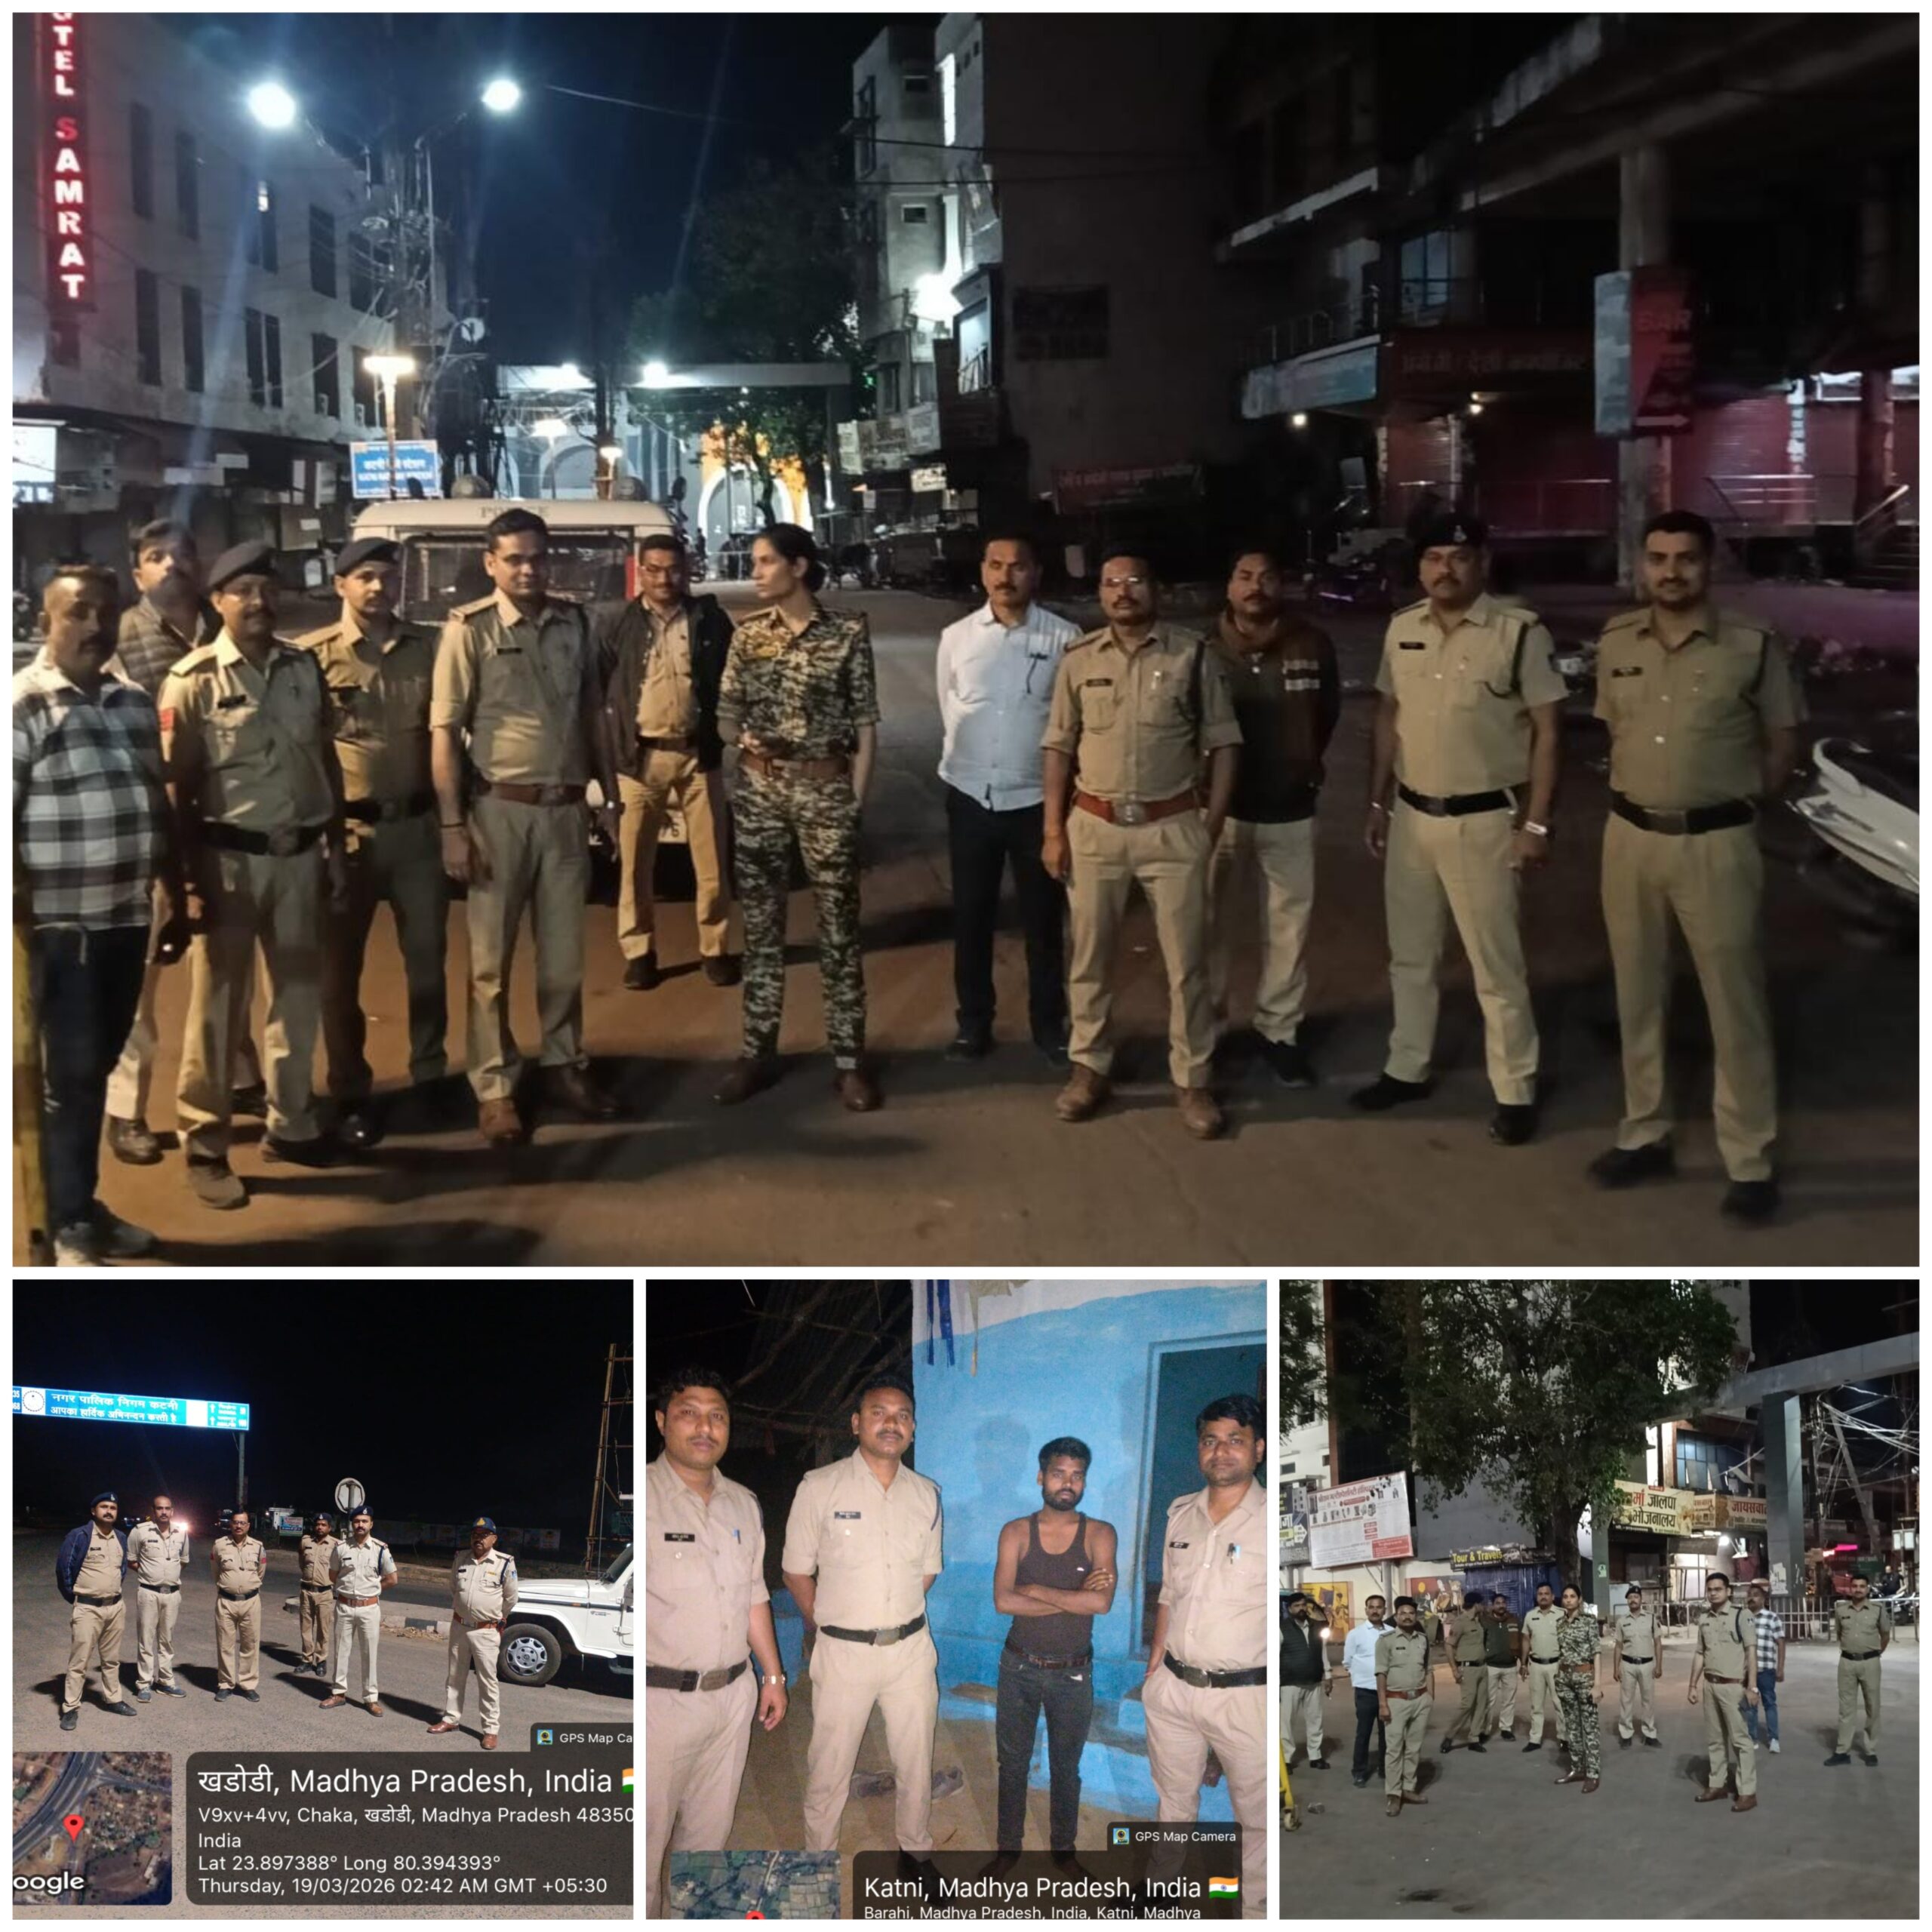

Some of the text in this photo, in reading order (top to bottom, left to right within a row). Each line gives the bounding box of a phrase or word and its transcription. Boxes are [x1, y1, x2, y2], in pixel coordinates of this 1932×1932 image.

[54, 117, 85, 299] SAMRAT
[51, 1392, 179, 1411] नगर पालिक निगम कटनी
[51, 1406, 78, 1417] आपका
[107, 1409, 146, 1421] अभिनन्दन
[147, 1411, 169, 1423] करती
[171, 1413, 178, 1424] है
[1647, 1494, 1677, 1510] जालपा
[1632, 1506, 1676, 1527] भोजनालय
[1453, 1549, 1503, 1563] Tour & Travels
